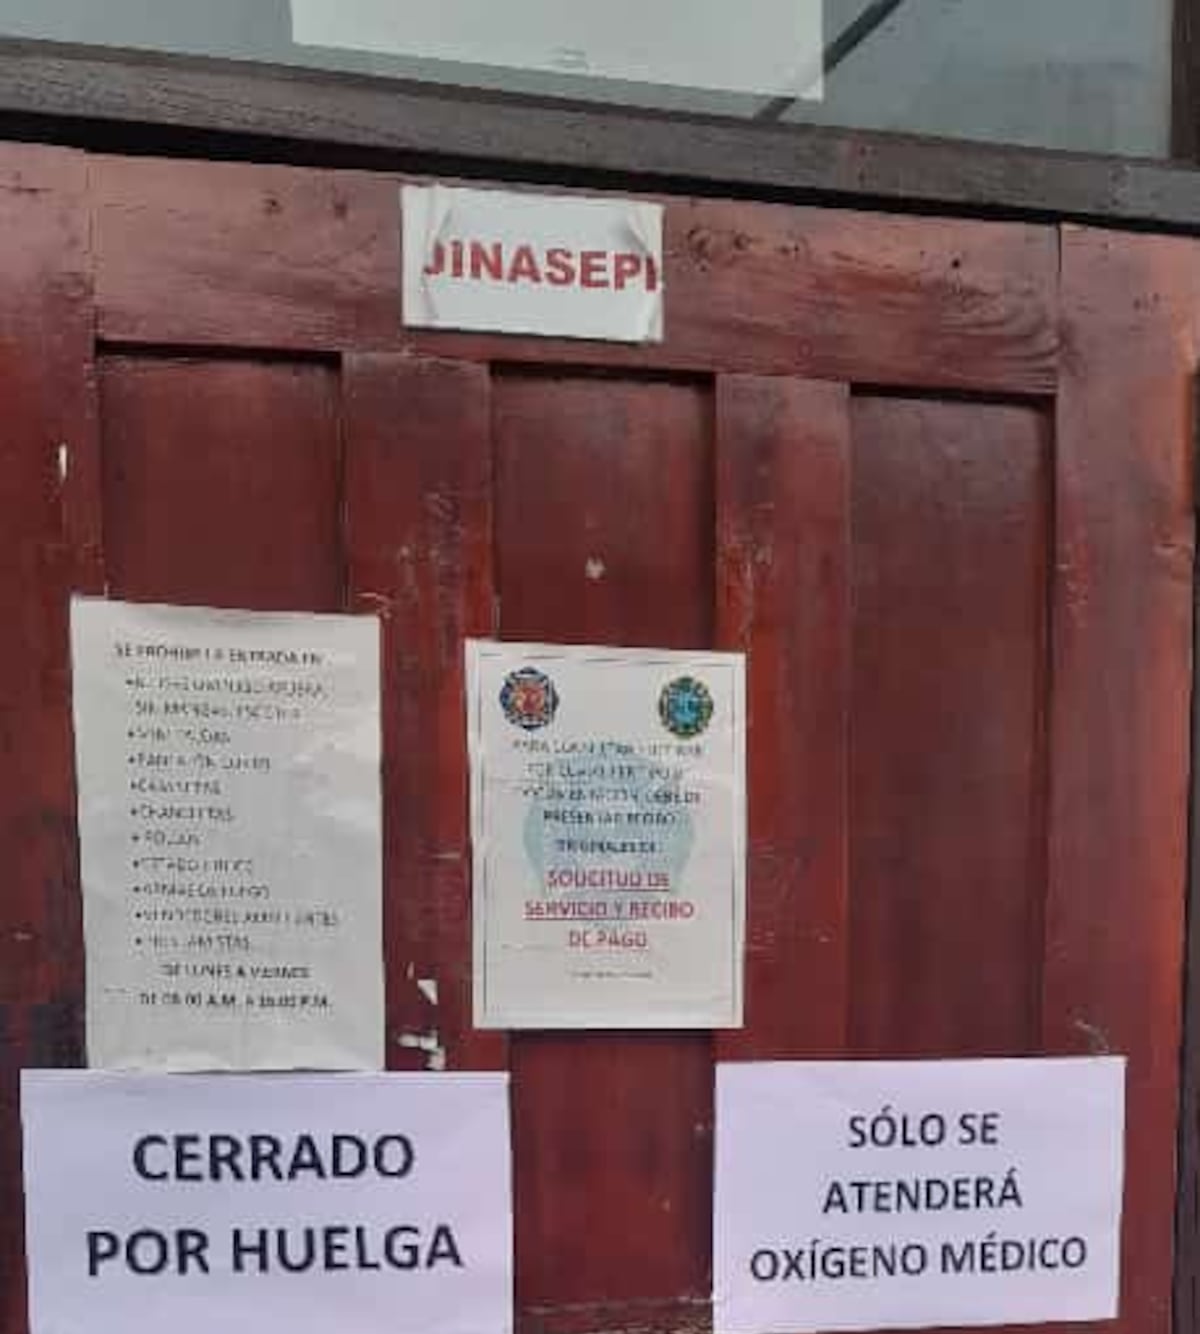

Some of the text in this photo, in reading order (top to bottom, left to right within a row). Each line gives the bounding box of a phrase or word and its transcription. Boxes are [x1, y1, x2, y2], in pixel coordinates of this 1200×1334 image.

[525, 901, 694, 919] SERVICIO Y RECIBO
[597, 930, 647, 947] PAGO
[849, 1105, 1000, 1147] SÓLO SE
[133, 1133, 414, 1181] CERRADO
[822, 1168, 1022, 1214] ATENDERÁ
[86, 1225, 463, 1276] POR HUELGA
[750, 1232, 1087, 1281] OXÍGENO MÉDICO
